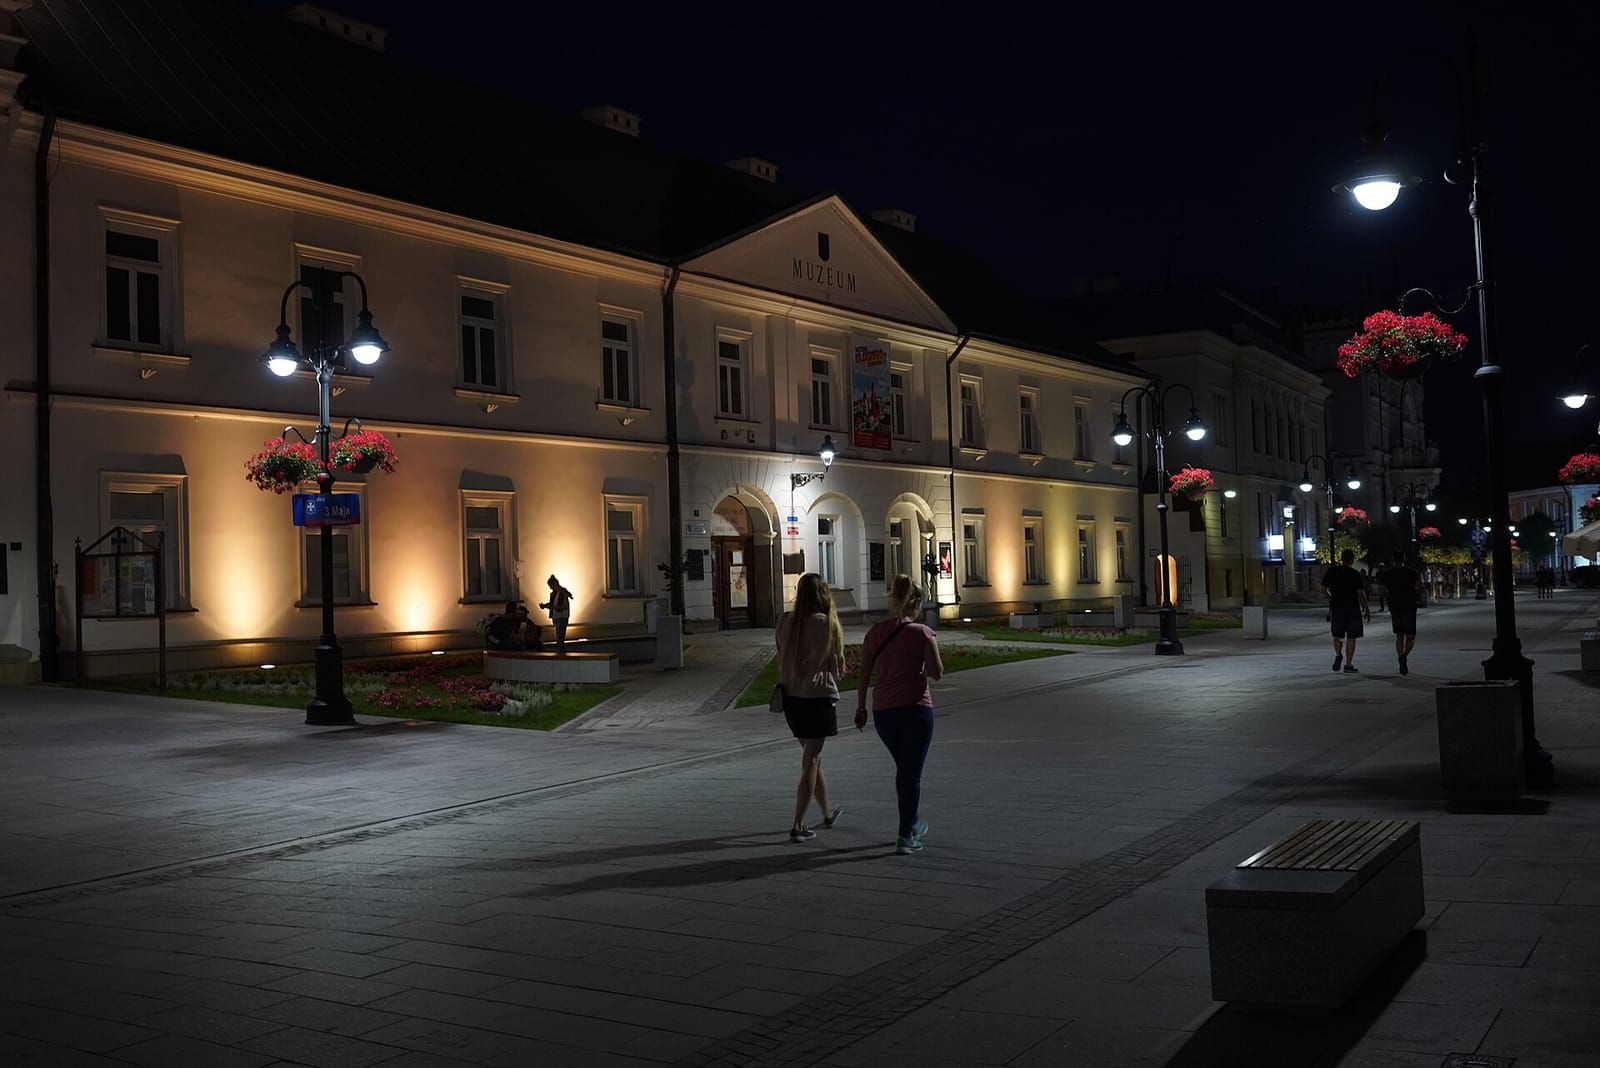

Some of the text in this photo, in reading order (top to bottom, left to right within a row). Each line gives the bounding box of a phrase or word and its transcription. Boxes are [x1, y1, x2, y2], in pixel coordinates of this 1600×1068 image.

[793, 258, 855, 292] MUZEUM
[324, 505, 351, 518] 3 Maja
